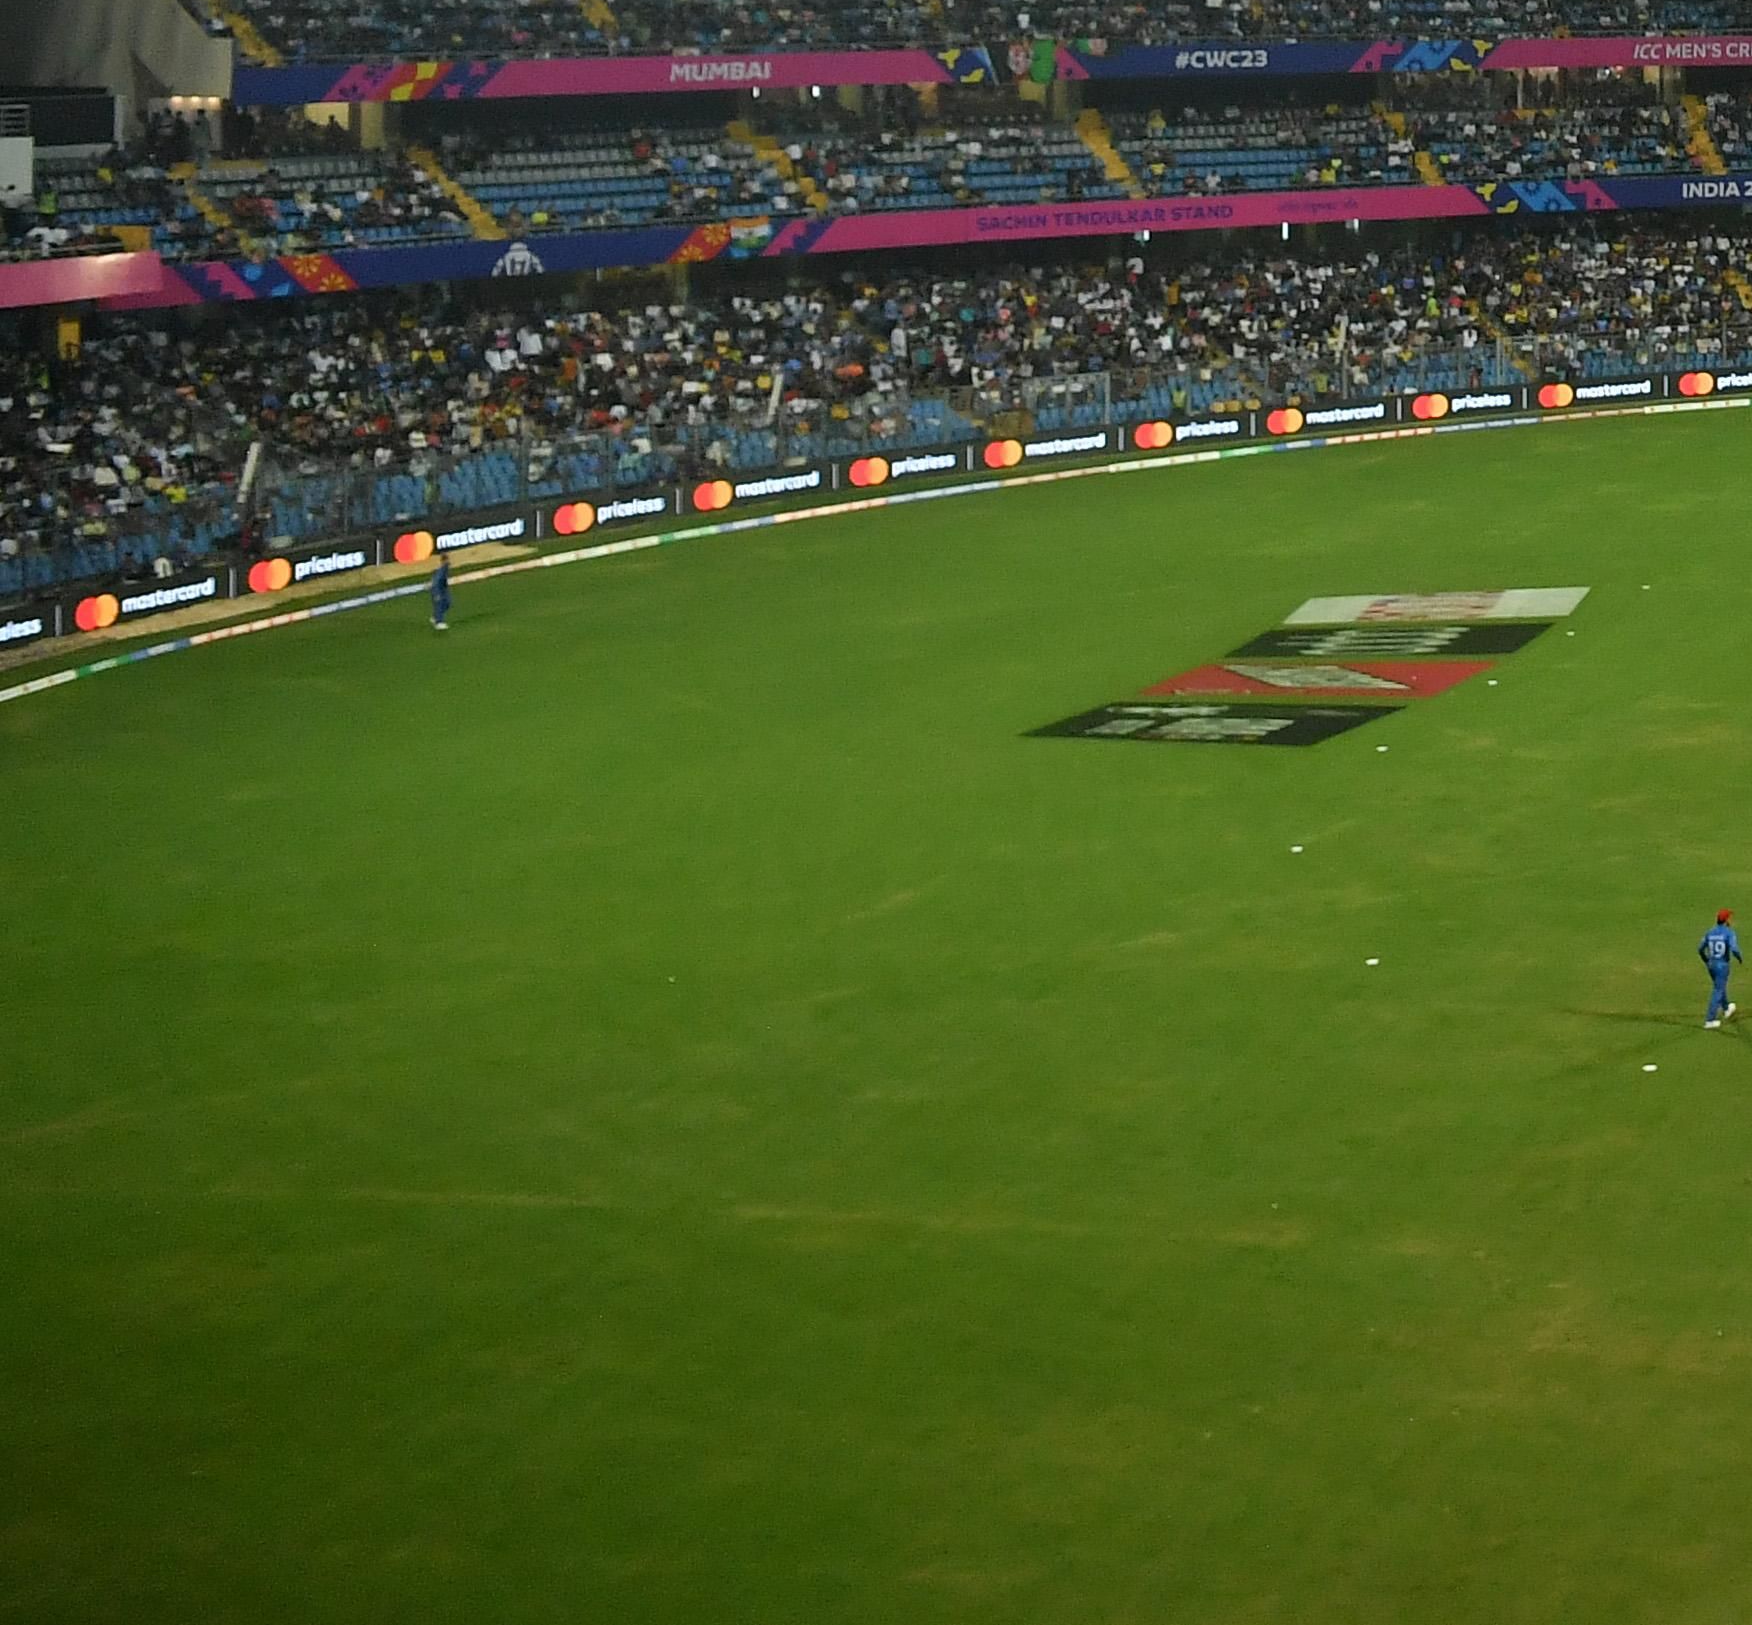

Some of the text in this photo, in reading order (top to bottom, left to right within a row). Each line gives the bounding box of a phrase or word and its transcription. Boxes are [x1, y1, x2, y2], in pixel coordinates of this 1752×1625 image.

[1175, 49, 1269, 70] #CWC23
[1633, 43, 1664, 60] ICC
[1666, 43, 1721, 59] MEN'S
[670, 60, 772, 82] MUMBAI
[1682, 182, 1740, 199] INDIA
[975, 205, 1234, 232] SACHIN TENDULKAR STAND
[1575, 379, 1651, 399] mastercard
[1305, 403, 1385, 425] mastercard
[1451, 393, 1512, 413] priceless
[1175, 420, 1239, 442] priceless
[1024, 432, 1106, 457] mastercard
[891, 454, 956, 478] priceless
[735, 470, 820, 499] mastercard
[597, 497, 666, 525] priceless
[436, 518, 524, 549] mastercard
[294, 551, 365, 581] priceless
[120, 577, 216, 614] mastercard
